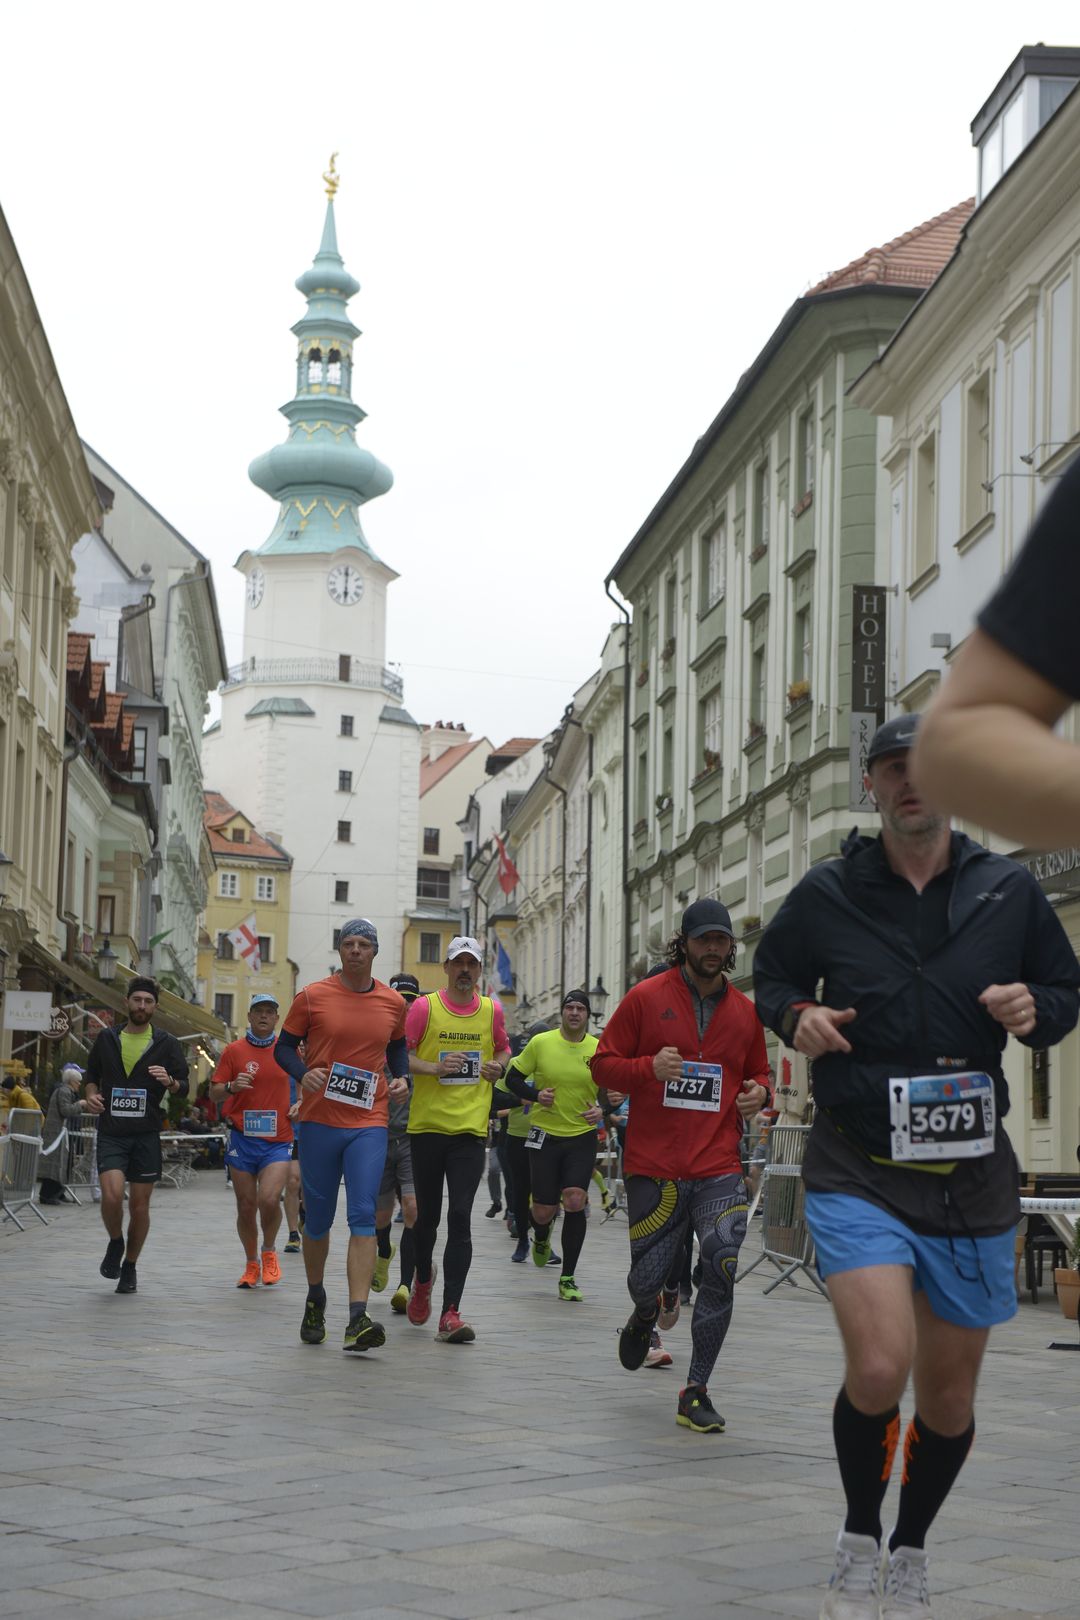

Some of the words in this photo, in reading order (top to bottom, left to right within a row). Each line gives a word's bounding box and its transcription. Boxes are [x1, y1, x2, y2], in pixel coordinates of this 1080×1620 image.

[860, 594, 879, 707] HOTEL
[447, 1032, 481, 1041] AUTOFUNIA
[329, 1075, 359, 1093] 2415
[668, 1077, 707, 1095] 4737
[112, 1098, 138, 1108] 4698
[245, 1119, 261, 1129] 1111
[911, 1102, 976, 1133] 3679
